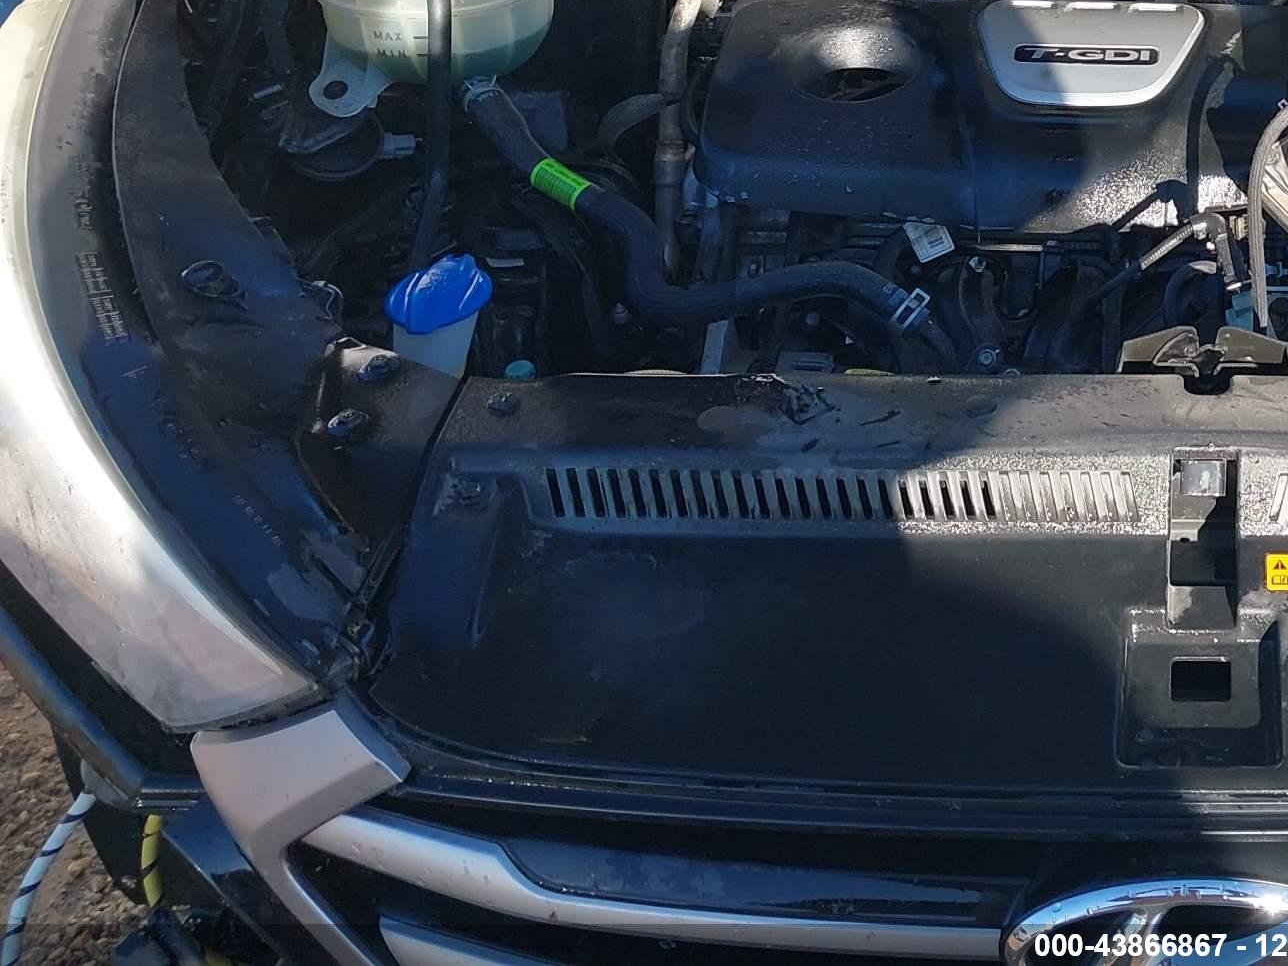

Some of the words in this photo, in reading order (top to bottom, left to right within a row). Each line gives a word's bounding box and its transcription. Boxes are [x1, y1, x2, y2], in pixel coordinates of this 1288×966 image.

[372, 30, 403, 41] MAX
[376, 48, 408, 58] MIN
[1023, 47, 1151, 61] T-GDI
